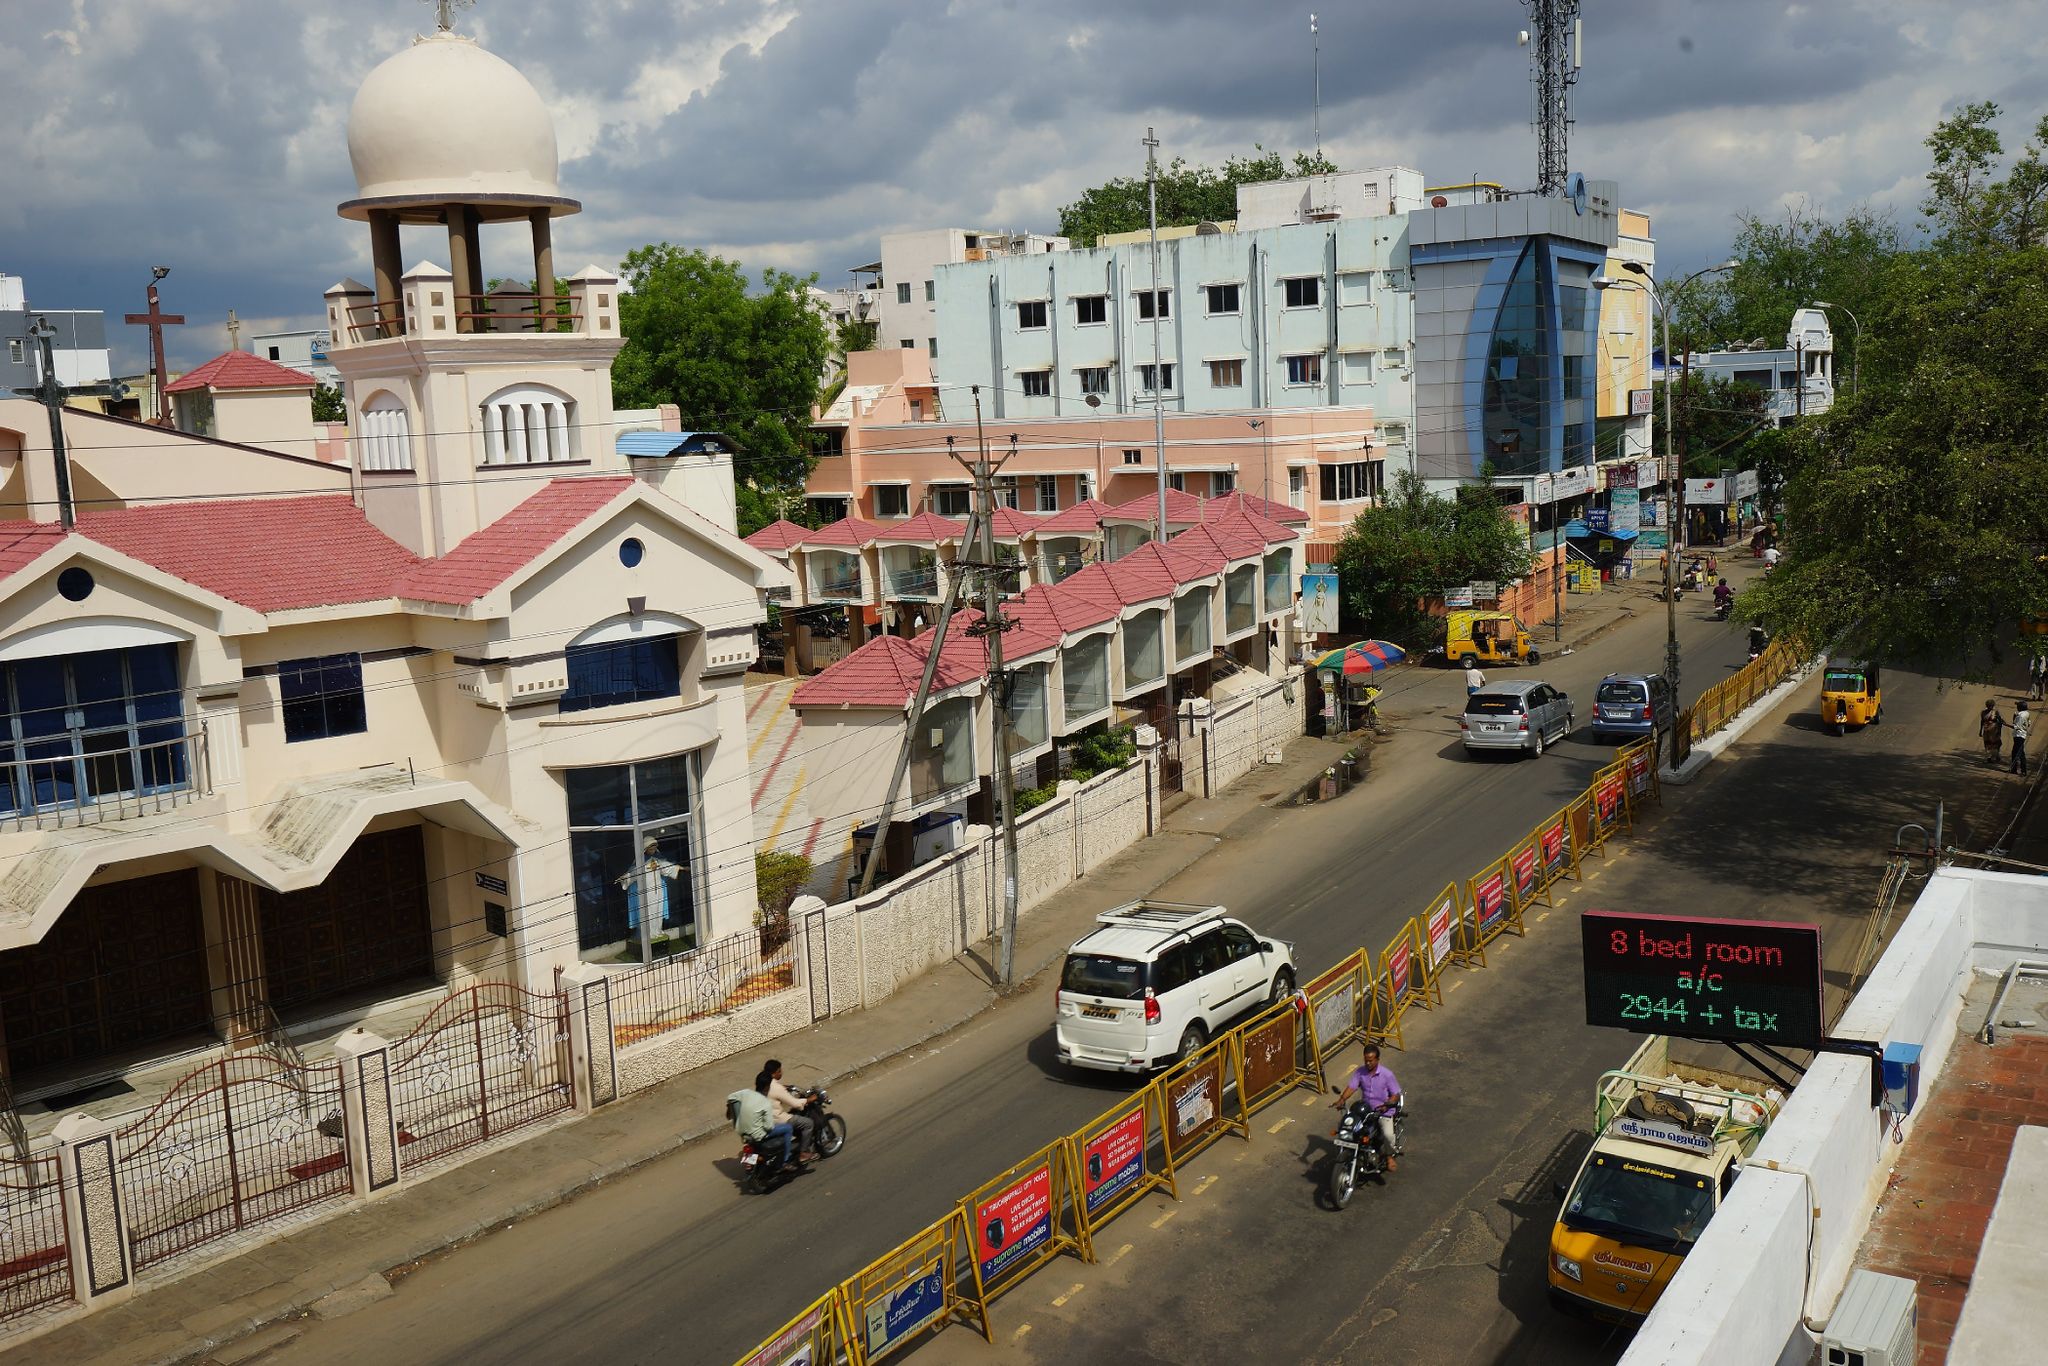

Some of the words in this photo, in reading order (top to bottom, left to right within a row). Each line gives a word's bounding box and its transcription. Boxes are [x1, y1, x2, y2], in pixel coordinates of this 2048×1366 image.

[1610, 930, 1628, 954] 8
[1639, 929, 1692, 959] bed
[1705, 942, 1783, 966] room
[1677, 964, 1723, 995] a/c
[1620, 993, 1688, 1023] 2944
[1700, 1004, 1722, 1025] +
[1733, 1005, 1779, 1032] tax
[1640, 1127, 1666, 1139] ராம
[1010, 1202, 1021, 1214] LIVE
[1011, 1219, 1026, 1234] WEAR
[1023, 1224, 1047, 1247] mobiles
